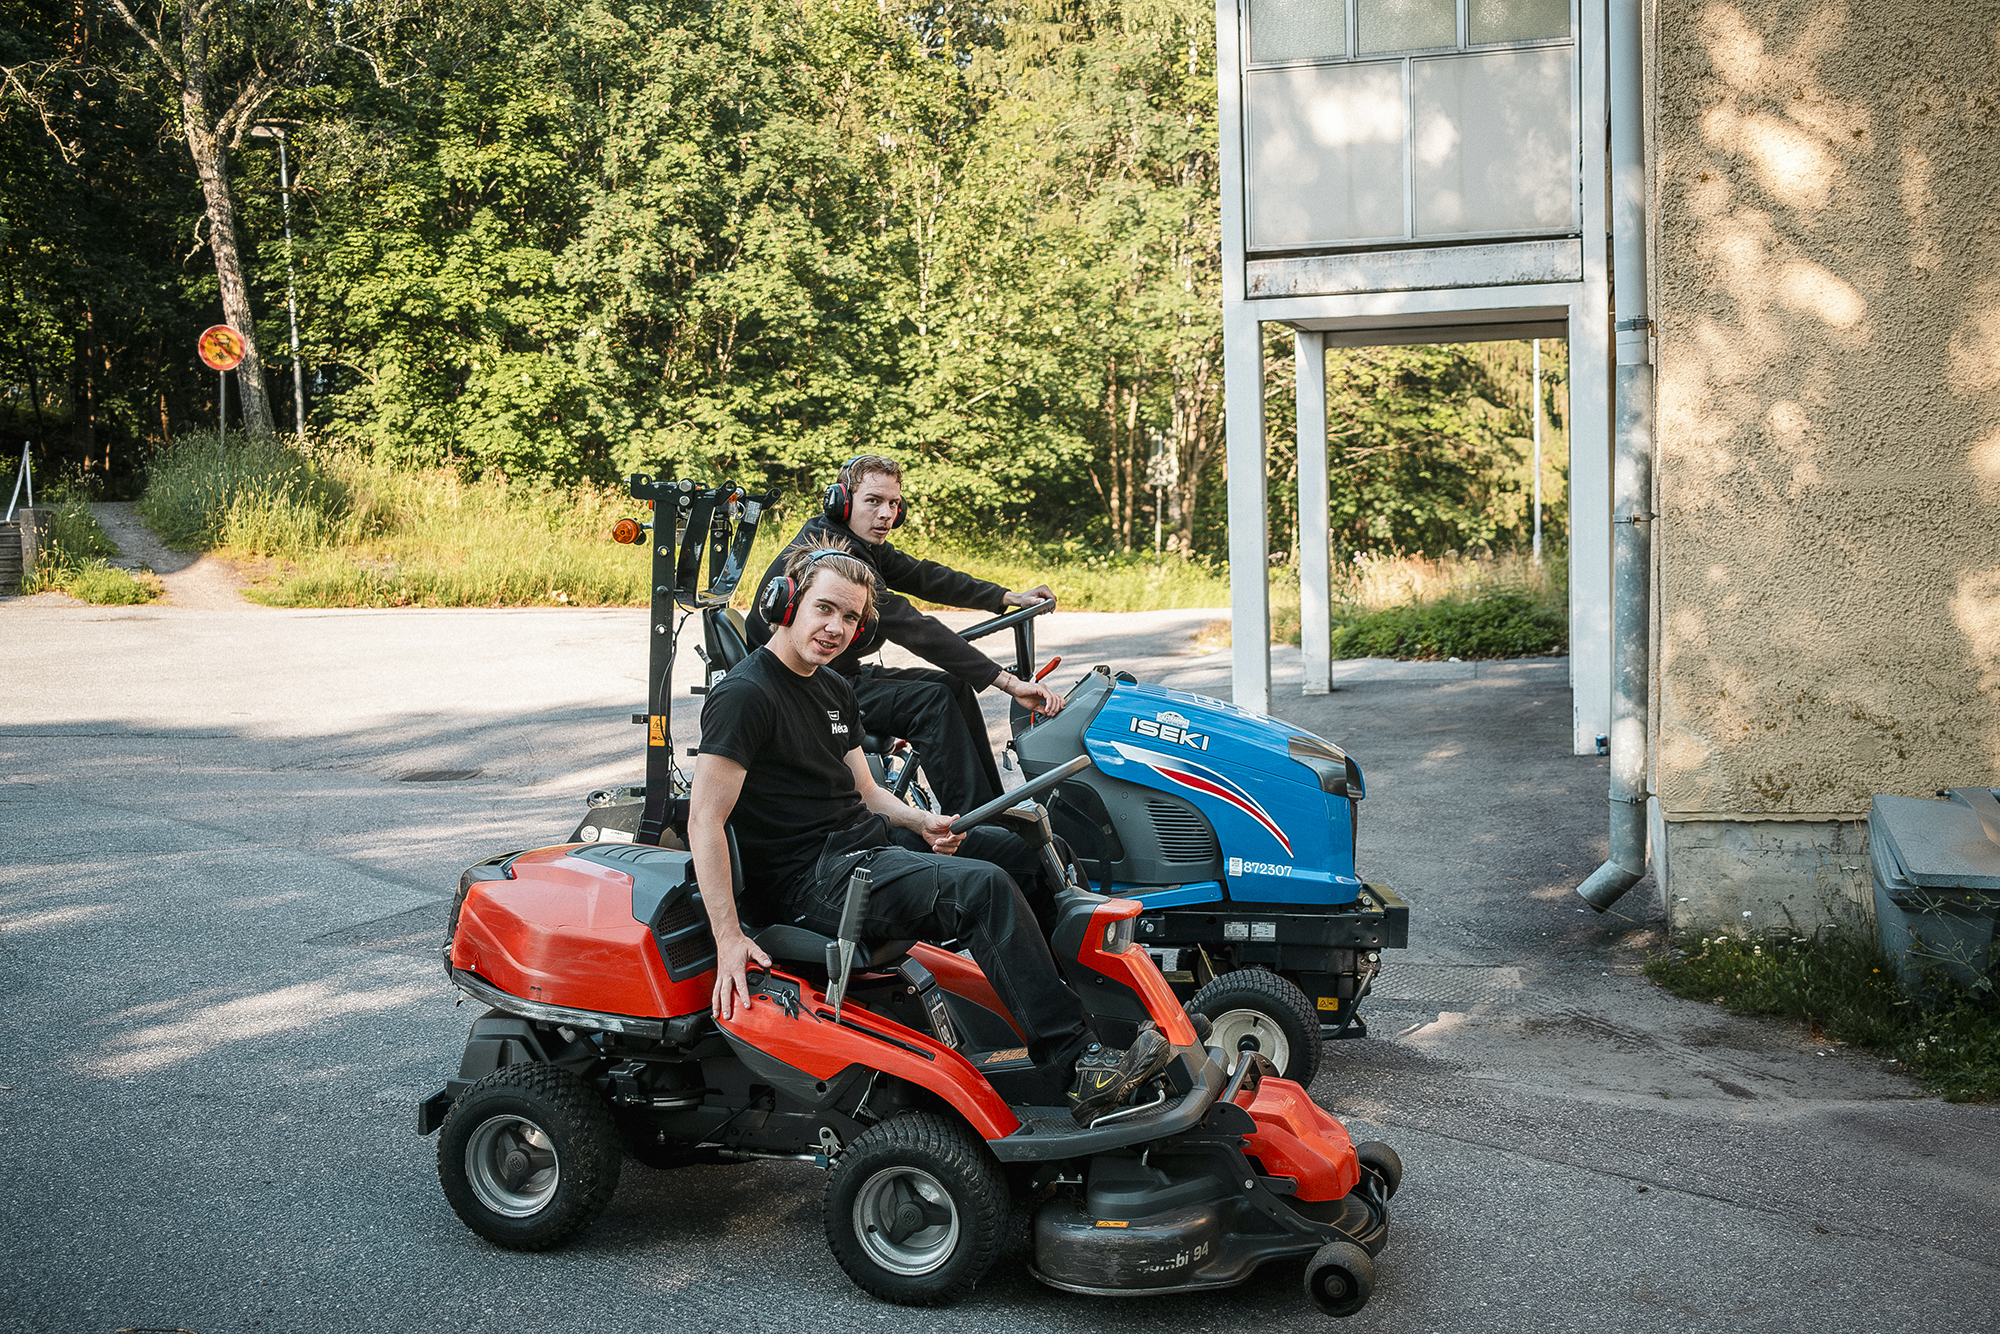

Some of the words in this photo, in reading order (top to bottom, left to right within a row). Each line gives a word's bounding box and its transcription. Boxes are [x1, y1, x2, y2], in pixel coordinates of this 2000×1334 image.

[1129, 716, 1210, 751] ISEKI
[1243, 861, 1293, 877] 872307
[1193, 1240, 1209, 1262] 94
